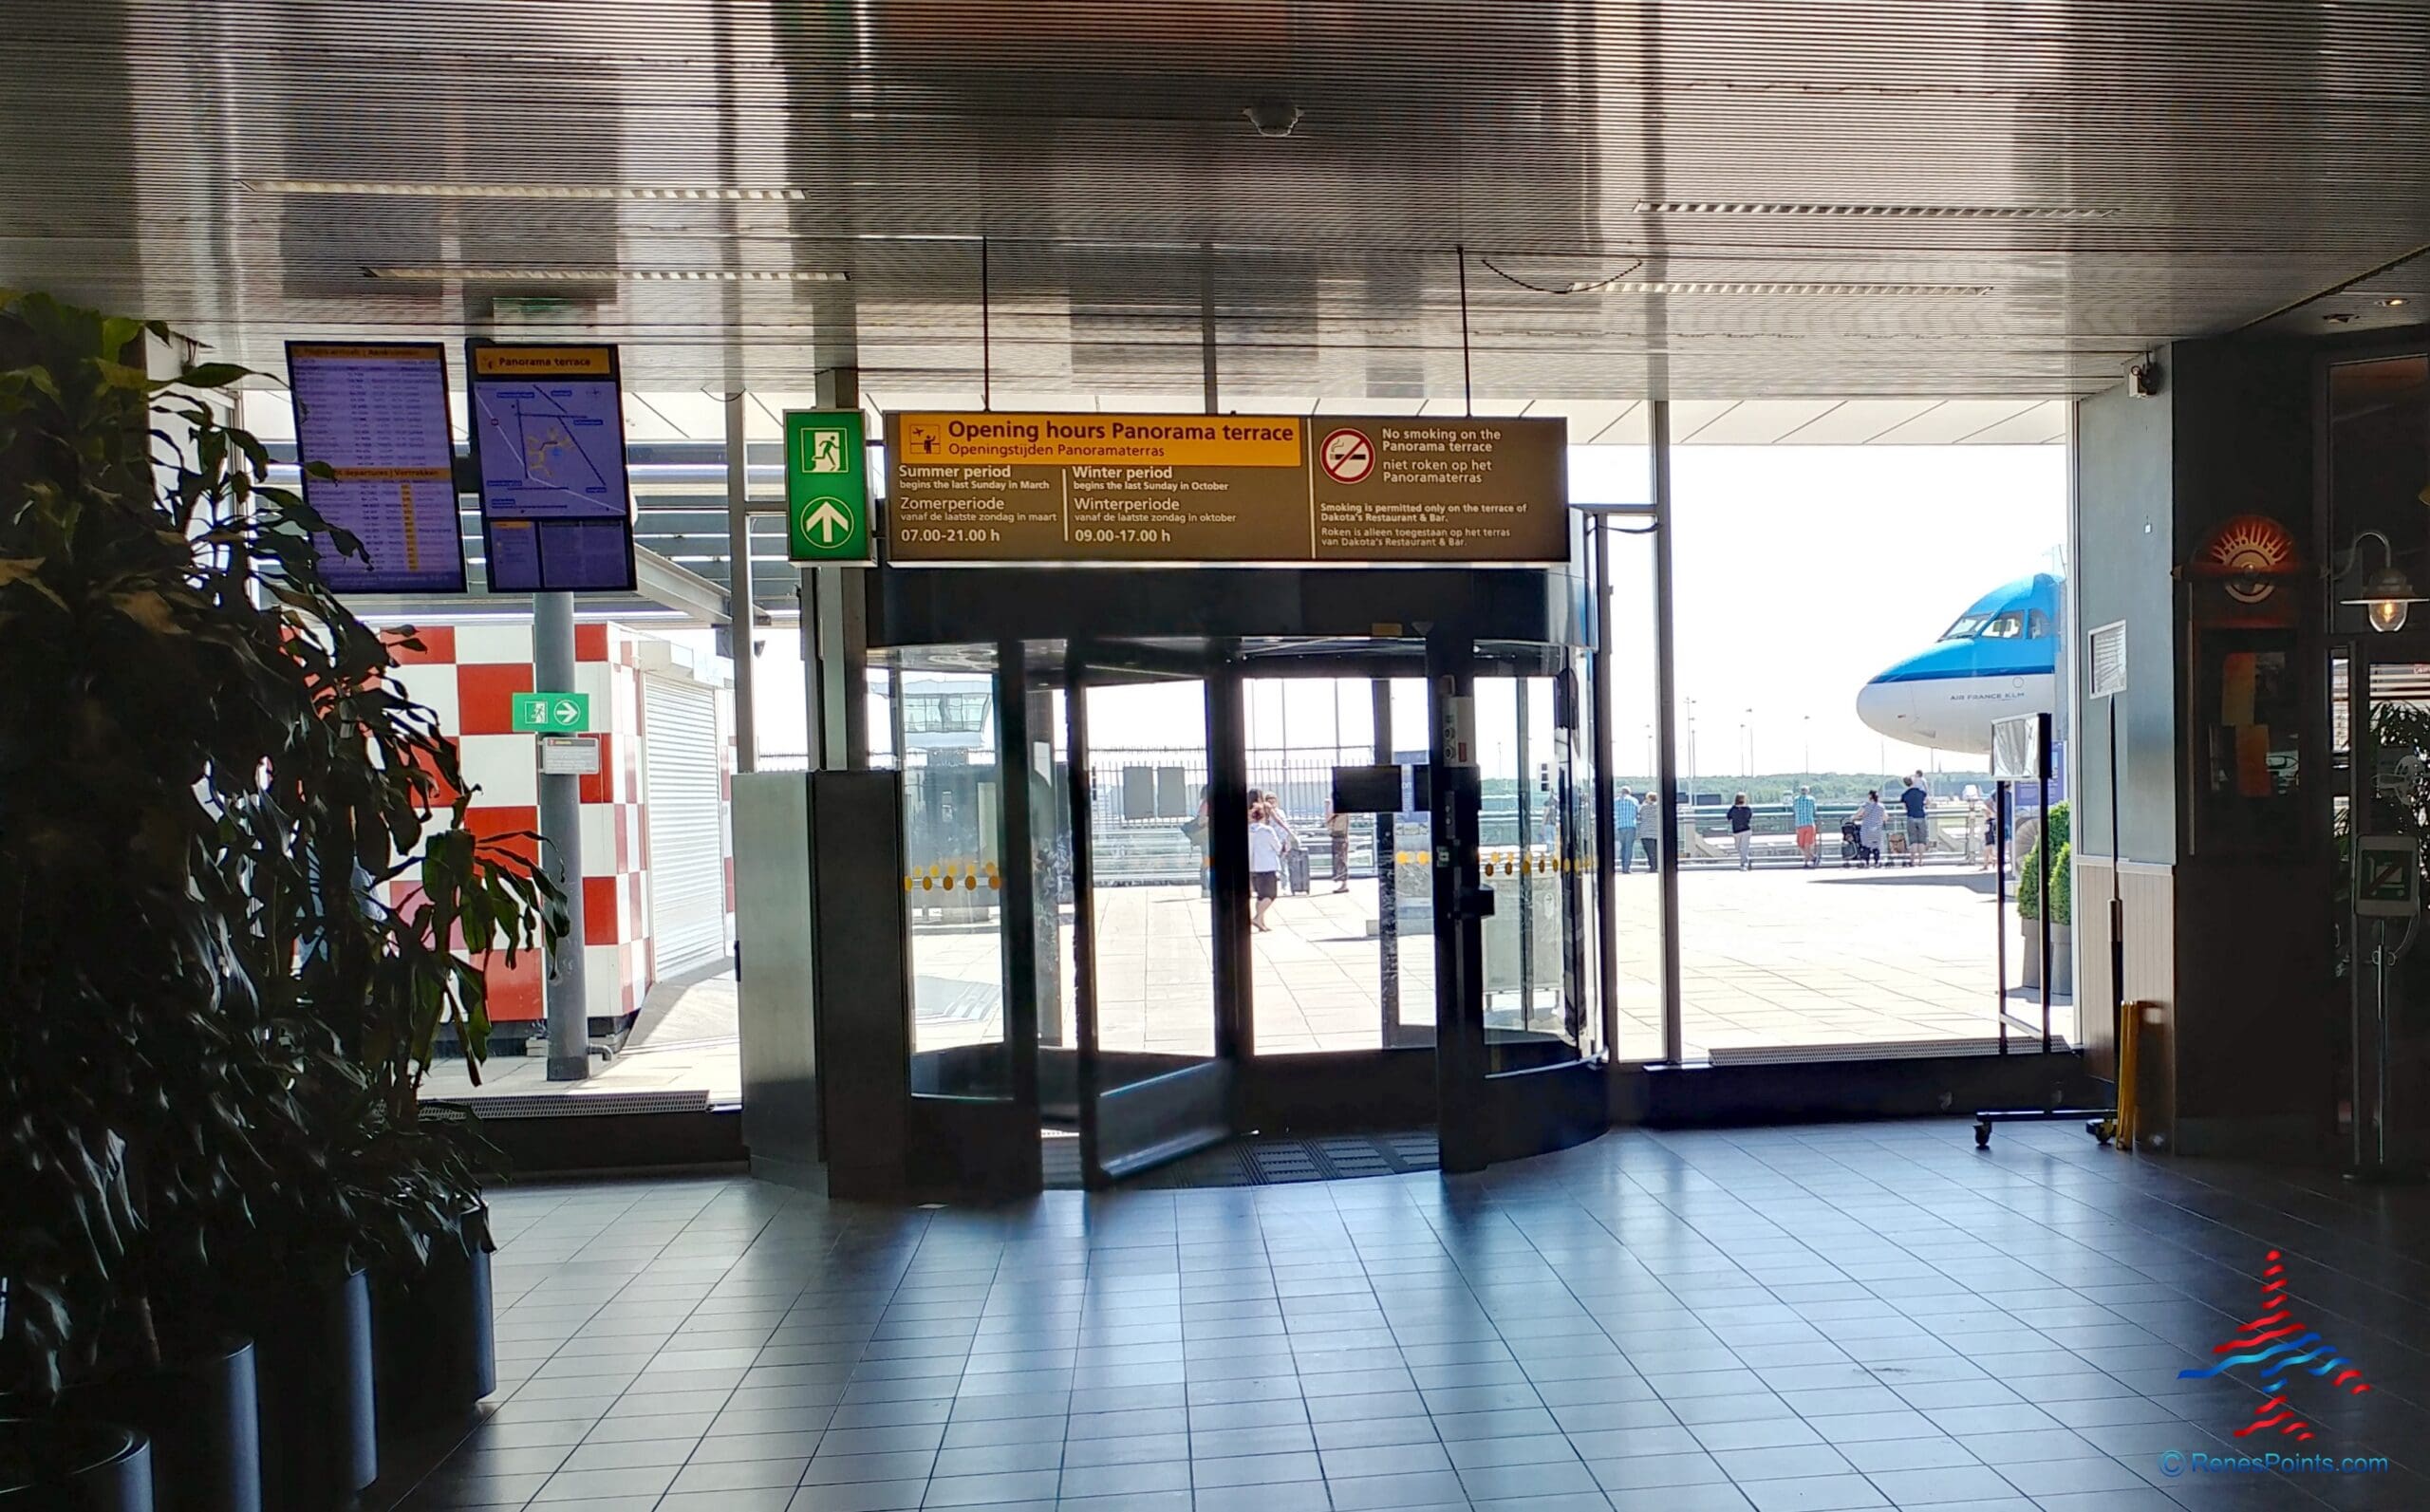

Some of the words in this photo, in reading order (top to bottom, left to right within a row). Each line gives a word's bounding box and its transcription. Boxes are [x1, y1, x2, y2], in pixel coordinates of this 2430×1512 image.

[499, 358, 551, 366] Panorama
[948, 420, 1039, 442] Opening
[1047, 421, 1105, 439] hours
[1112, 422, 1215, 440] Panorama
[1222, 423, 1293, 441] terrace
[1382, 429, 1400, 439] No
[1404, 428, 1456, 442] smoking
[1460, 431, 1476, 440] on
[1481, 430, 1501, 440] the
[948, 443, 1053, 457] Openingstijden
[1057, 444, 1165, 457] Panoramaterras
[1382, 441, 1445, 452] Panorama
[1449, 442, 1492, 452] terrace
[1383, 459, 1407, 471] niet
[1412, 460, 1448, 471] roken
[1451, 463, 1467, 473] op
[1471, 461, 1492, 471] het
[899, 465, 960, 477] Summer
[963, 466, 1011, 481] period
[1073, 466, 1123, 478] Winter
[1127, 467, 1172, 482] period
[1383, 473, 1483, 483] Panoramaterras
[900, 480, 929, 490] begins
[952, 481, 968, 490] last
[971, 481, 1005, 491] Sunday
[1008, 481, 1018, 490] in
[1020, 481, 1050, 490] March
[1074, 481, 1105, 491] begins
[1107, 481, 1122, 490] the
[1125, 481, 1142, 490] last
[1144, 481, 1178, 492] Sunday
[1181, 481, 1189, 491] in
[1191, 481, 1228, 491] October
[901, 497, 1004, 513] Zomerperiode
[1075, 498, 1179, 513] Winterperiode
[1321, 503, 1362, 514] Smoking
[1365, 504, 1373, 513] is
[1375, 504, 1422, 514] permitted
[1425, 504, 1446, 514] only
[1464, 504, 1479, 513] the
[1517, 504, 1527, 513] of
[901, 513, 927, 521] vanaf
[930, 513, 942, 521] de
[945, 513, 974, 521] laatste
[980, 513, 1014, 524] zondag
[1016, 513, 1025, 521] in
[1028, 513, 1056, 522] maart
[1075, 513, 1101, 521] vanaf
[1104, 513, 1116, 522] de
[1119, 513, 1148, 522] laatste
[1150, 513, 1187, 524] zondag
[1189, 513, 1198, 522] in
[1201, 513, 1236, 522] oktober
[1321, 513, 1363, 522] Dakota's
[1366, 513, 1416, 522] Restaurant
[902, 530, 985, 542] 07.00-21.00
[991, 530, 1000, 542] h
[1075, 530, 1157, 542] 09.00-17.00
[1162, 530, 1170, 542] h
[1321, 528, 1351, 536] Roken
[1354, 528, 1361, 536] is
[1364, 528, 1392, 536] alleen
[1395, 529, 1448, 539] toegestaan
[1450, 530, 1462, 539] op
[1466, 528, 1481, 537] het
[1483, 529, 1509, 537] terras
[1341, 537, 1382, 546] Dakota's
[1386, 537, 1436, 546] Restaurant
